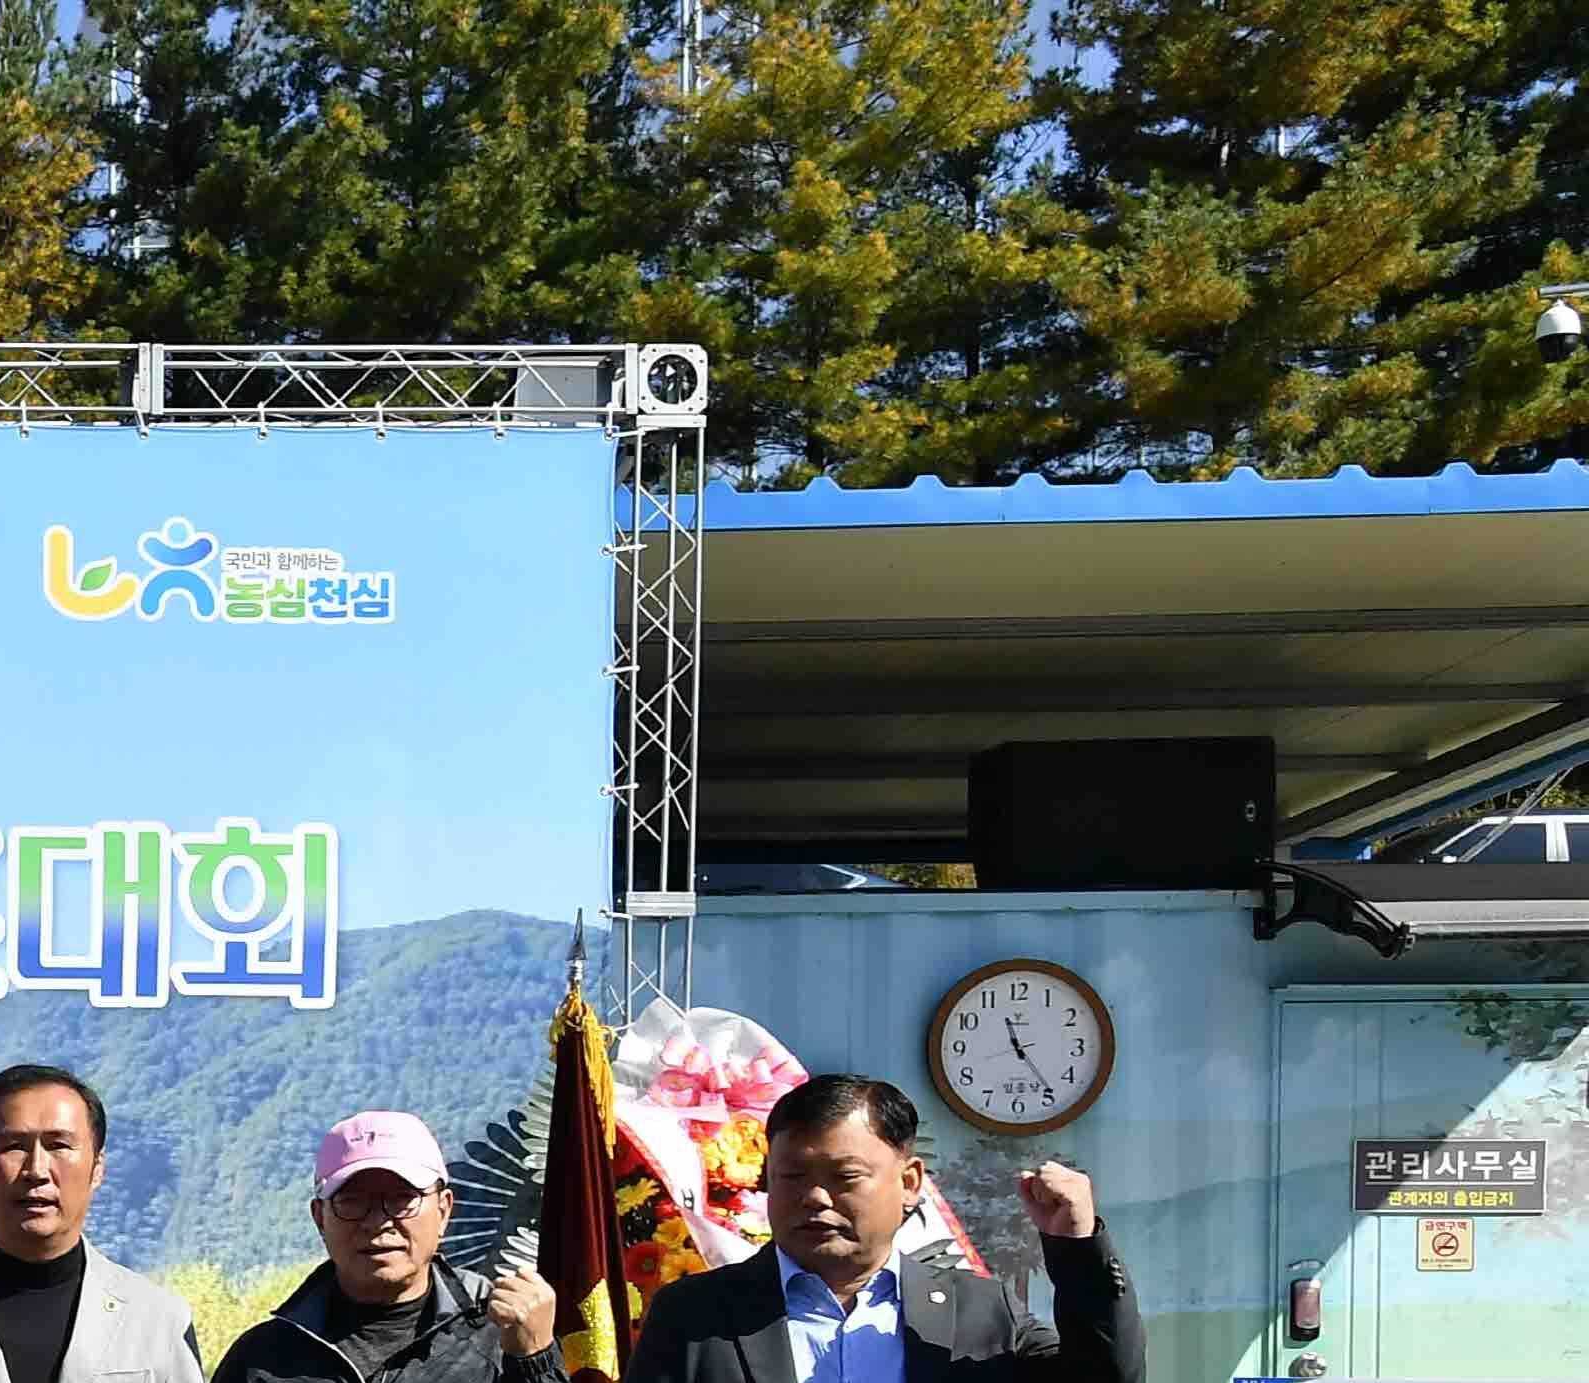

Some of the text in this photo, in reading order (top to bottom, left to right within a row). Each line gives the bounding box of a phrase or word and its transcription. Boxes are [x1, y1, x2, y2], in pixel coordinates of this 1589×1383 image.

[225, 551, 339, 571] 국민과 함께하는
[225, 577, 391, 619] 농심천심
[982, 990, 996, 1009] 11
[1011, 982, 1029, 1001] 12
[959, 1012, 979, 1031] 10
[1063, 1008, 1077, 1027] 2
[953, 1040, 966, 1056] 9
[1070, 1038, 1085, 1057] 3
[959, 1067, 974, 1086] 8
[1061, 1067, 1074, 1084] 4
[982, 1089, 994, 1108] 7
[1011, 1095, 1025, 1113] 6
[1042, 1089, 1055, 1107] 5
[1364, 1150, 1538, 1181] 관리사무실
[1388, 1191, 1448, 1207] 관계자외
